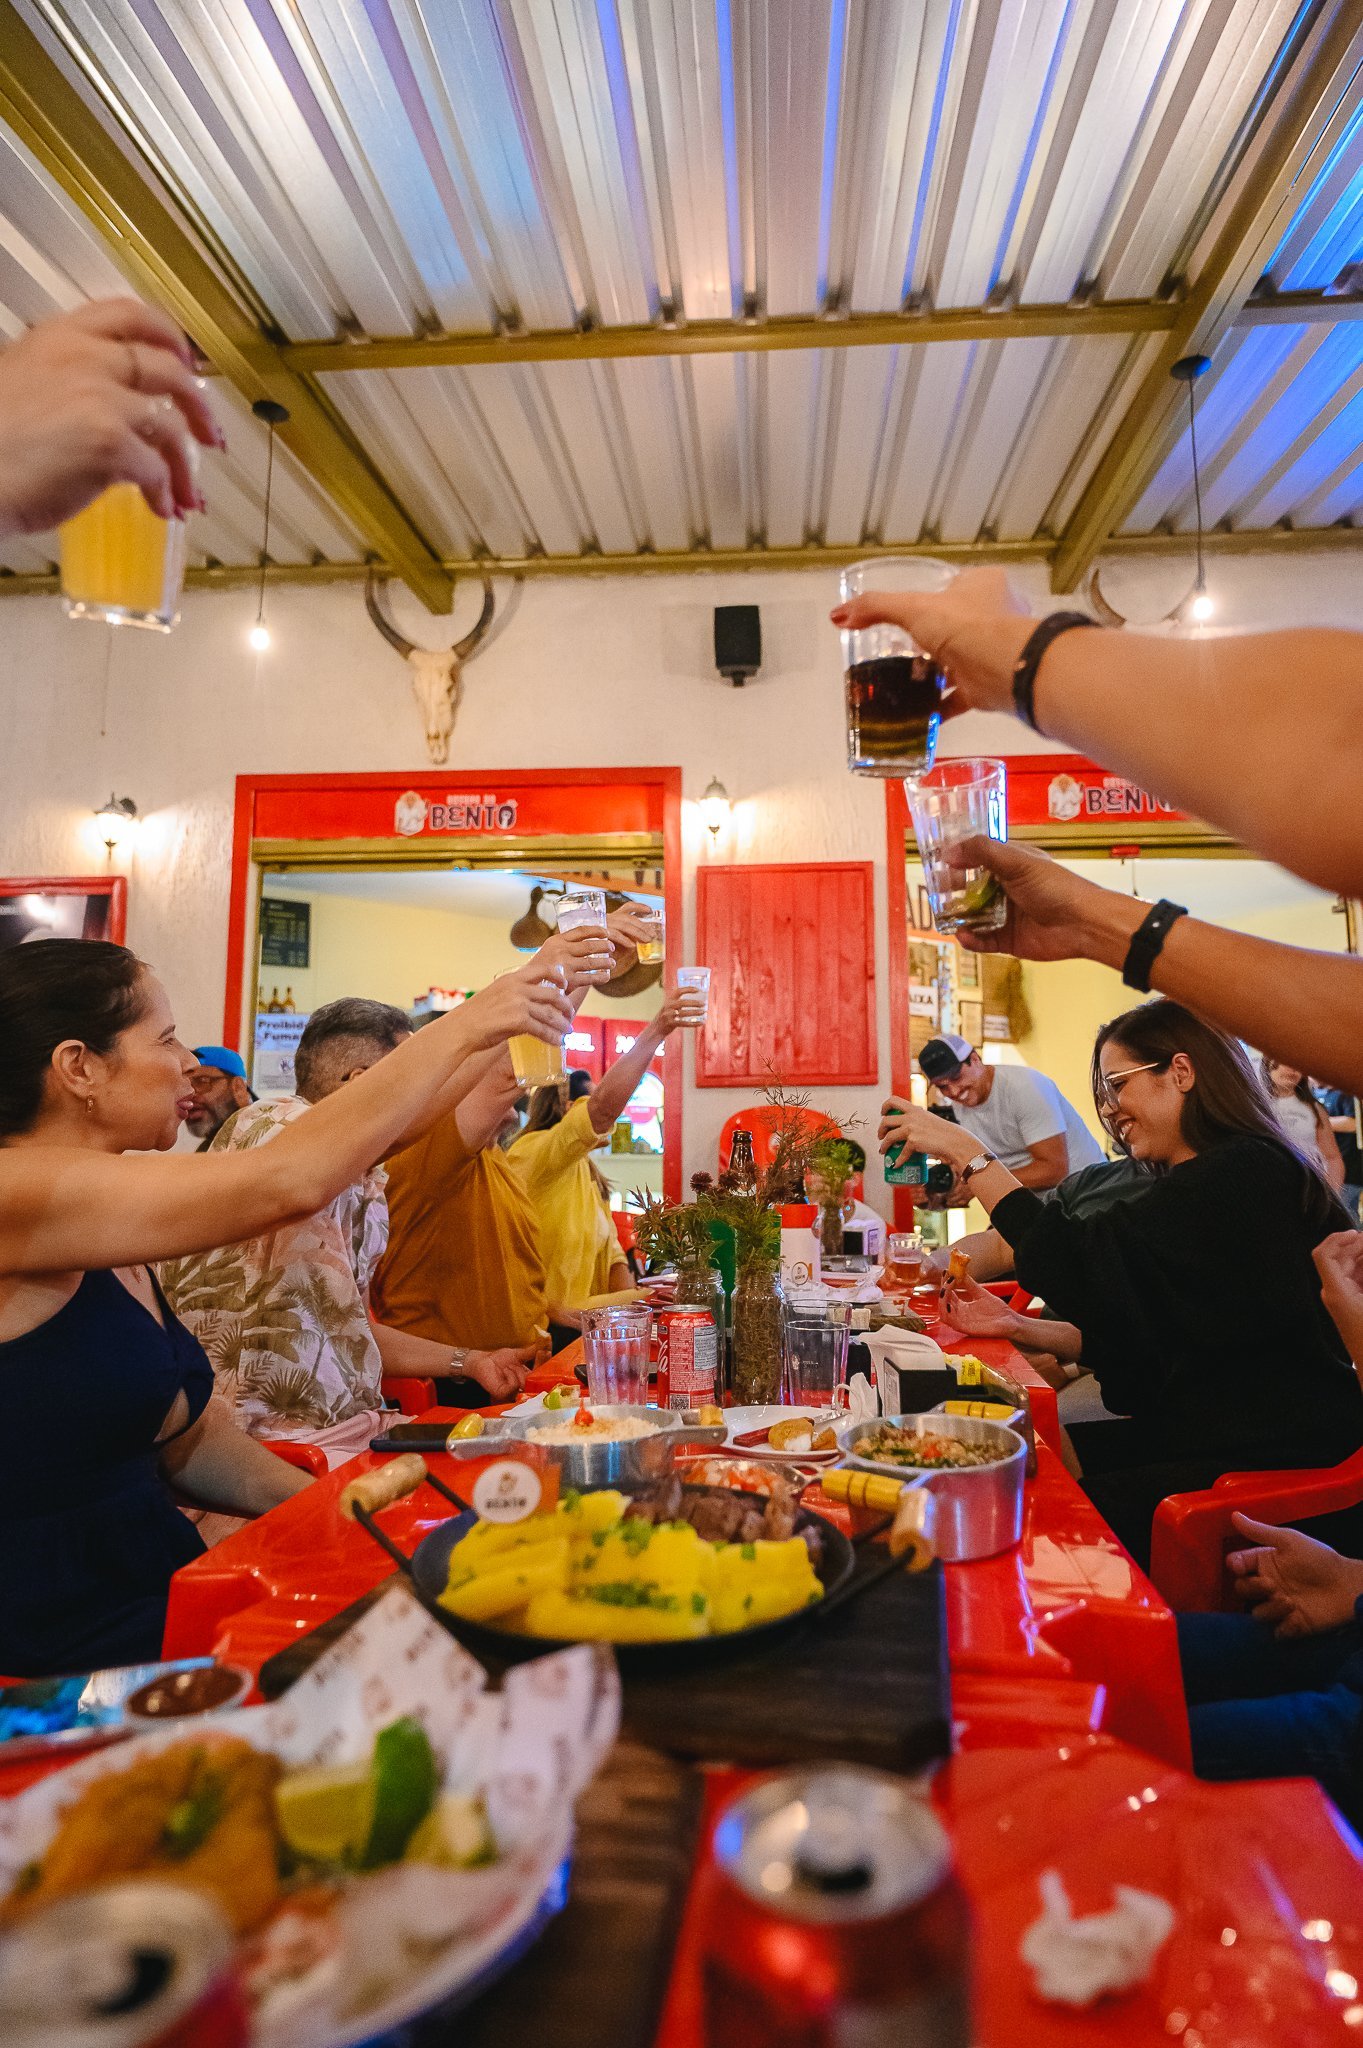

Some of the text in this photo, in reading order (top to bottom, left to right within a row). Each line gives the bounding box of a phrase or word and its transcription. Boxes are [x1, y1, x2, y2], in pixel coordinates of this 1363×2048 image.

[431, 804, 516, 829] BENTO
[258, 1019, 308, 1029] Proibid
[264, 1032, 300, 1040] Fuma
